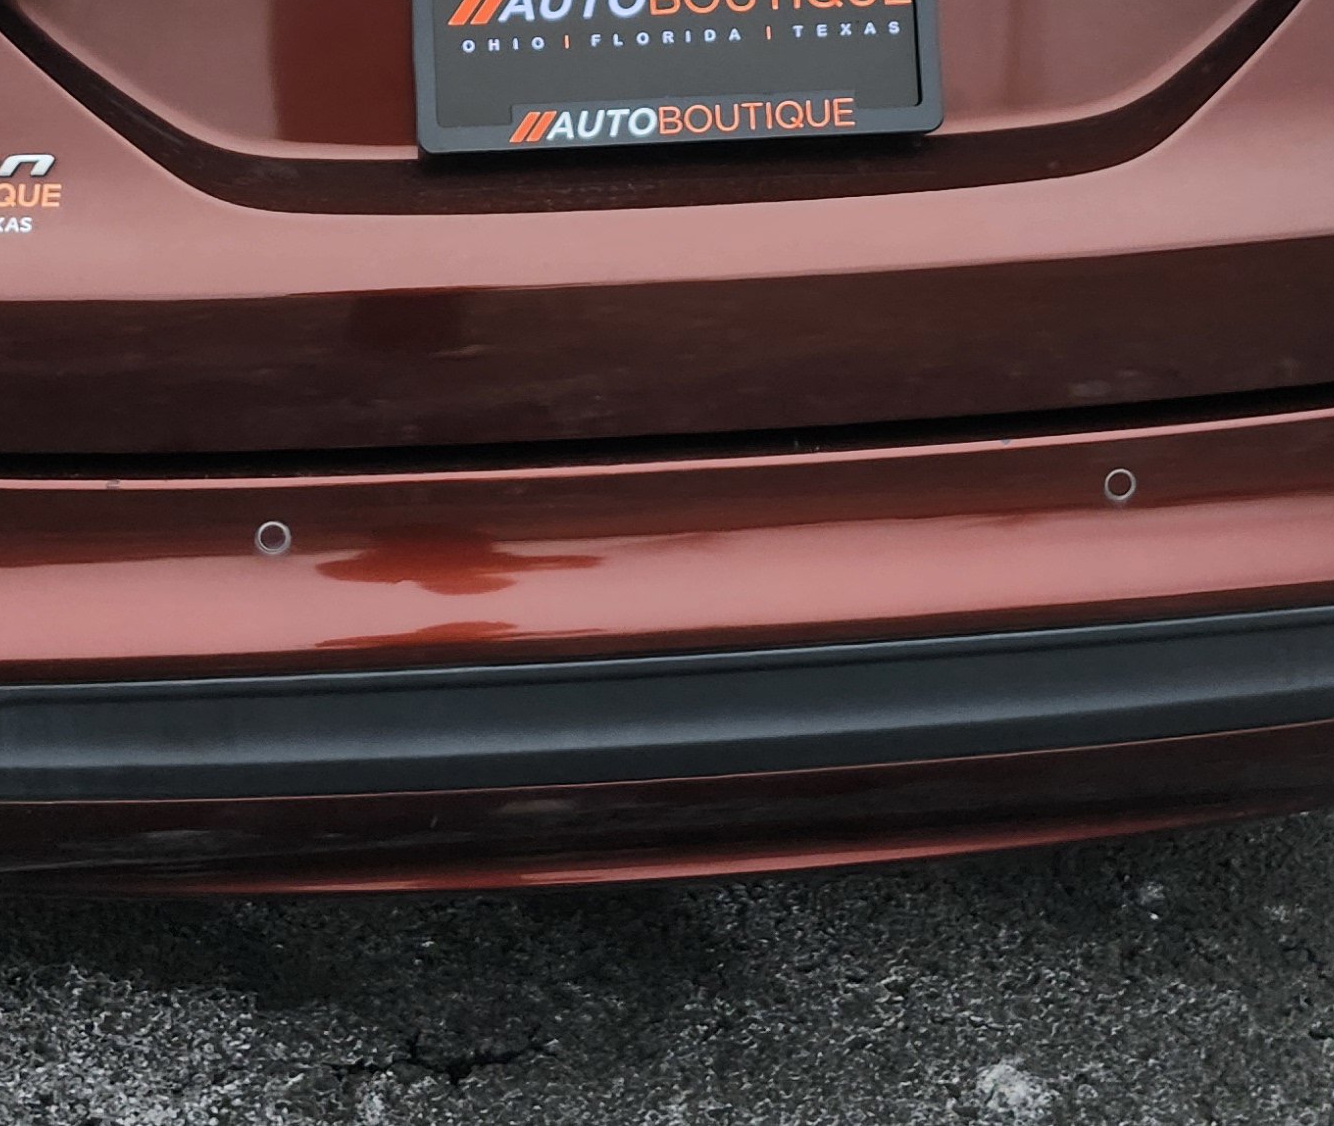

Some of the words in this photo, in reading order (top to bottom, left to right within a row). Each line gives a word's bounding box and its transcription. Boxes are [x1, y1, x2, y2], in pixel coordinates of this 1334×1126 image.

[462, 36, 546, 53] OHIO
[590, 29, 742, 47] FLORIDA
[793, 20, 902, 38] TEXAS
